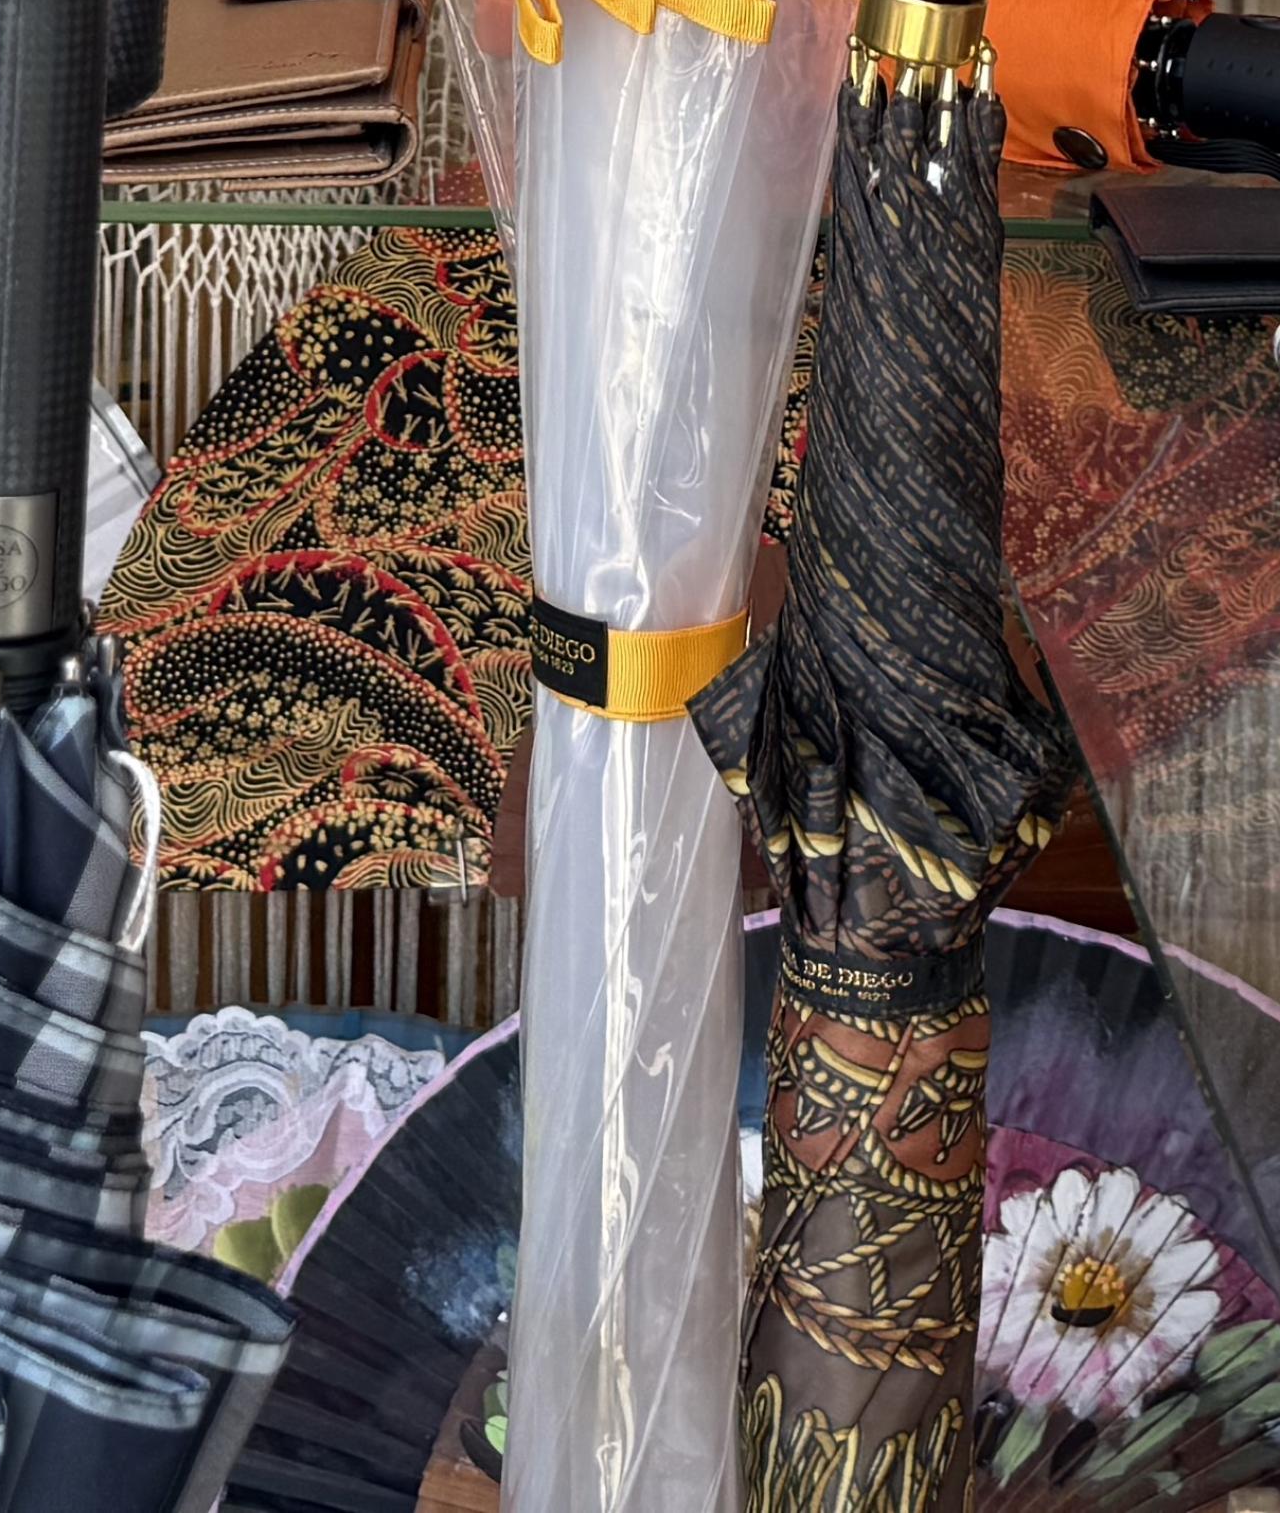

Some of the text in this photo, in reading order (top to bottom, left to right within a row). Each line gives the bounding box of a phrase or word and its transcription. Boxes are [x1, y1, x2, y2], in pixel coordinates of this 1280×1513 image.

[540, 624, 596, 664] DIEGO
[803, 958, 914, 989] DE DIEGO
